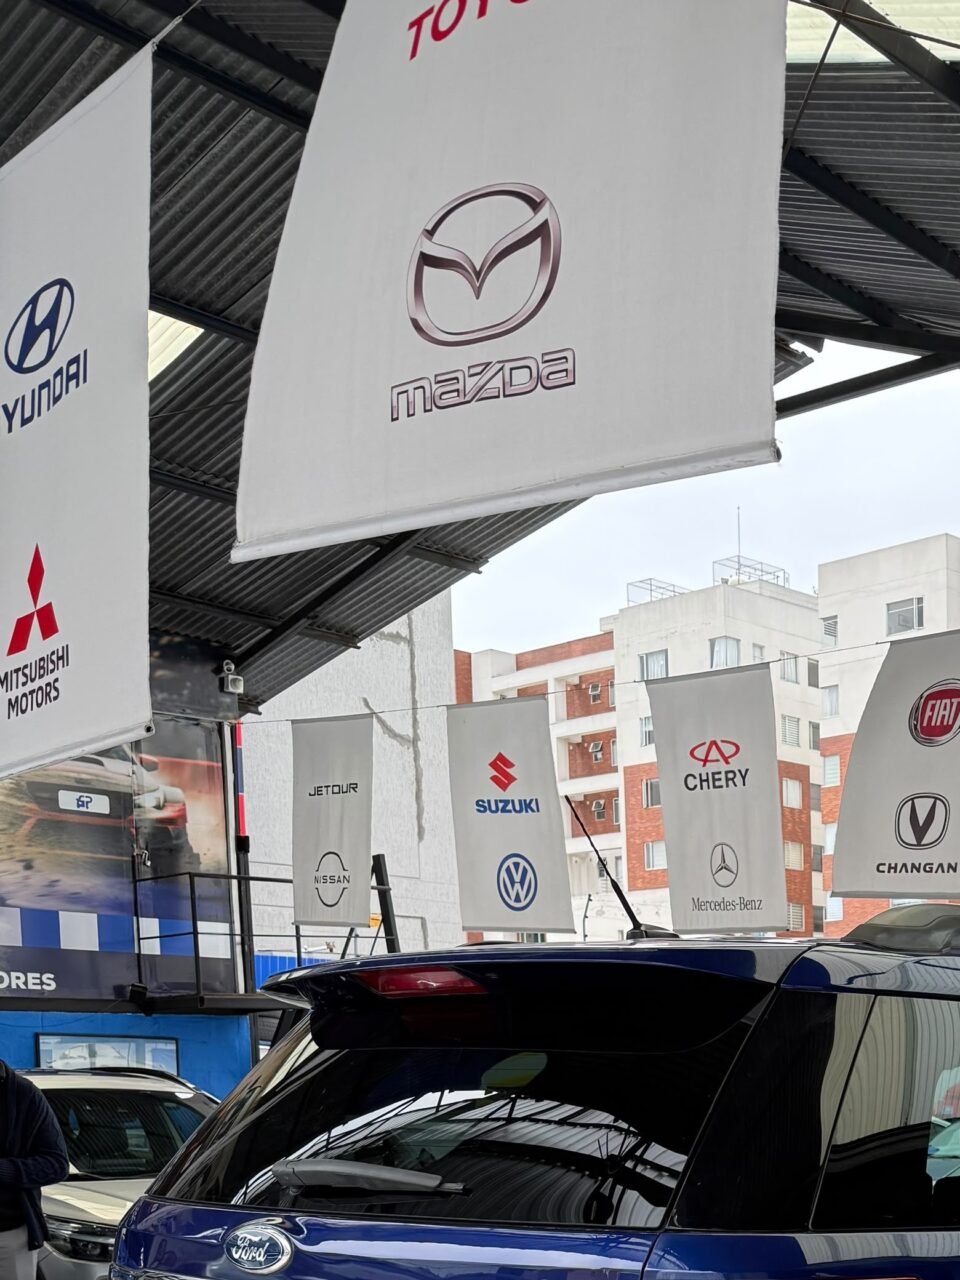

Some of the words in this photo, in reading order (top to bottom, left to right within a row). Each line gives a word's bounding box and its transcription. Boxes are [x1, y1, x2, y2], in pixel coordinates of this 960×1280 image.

[0, 644, 70, 693] MITSUBISHI
[7, 677, 60, 720] MOTORS
[683, 768, 750, 792] CHERY
[308, 782, 359, 797] JETOUR
[475, 798, 540, 814] SUZUKI
[875, 861, 958, 874] CHANGAN
[313, 874, 351, 885] NISSAN
[691, 896, 763, 912] Mercedes-Benz
[230, 1233, 271, 1262] Ford
